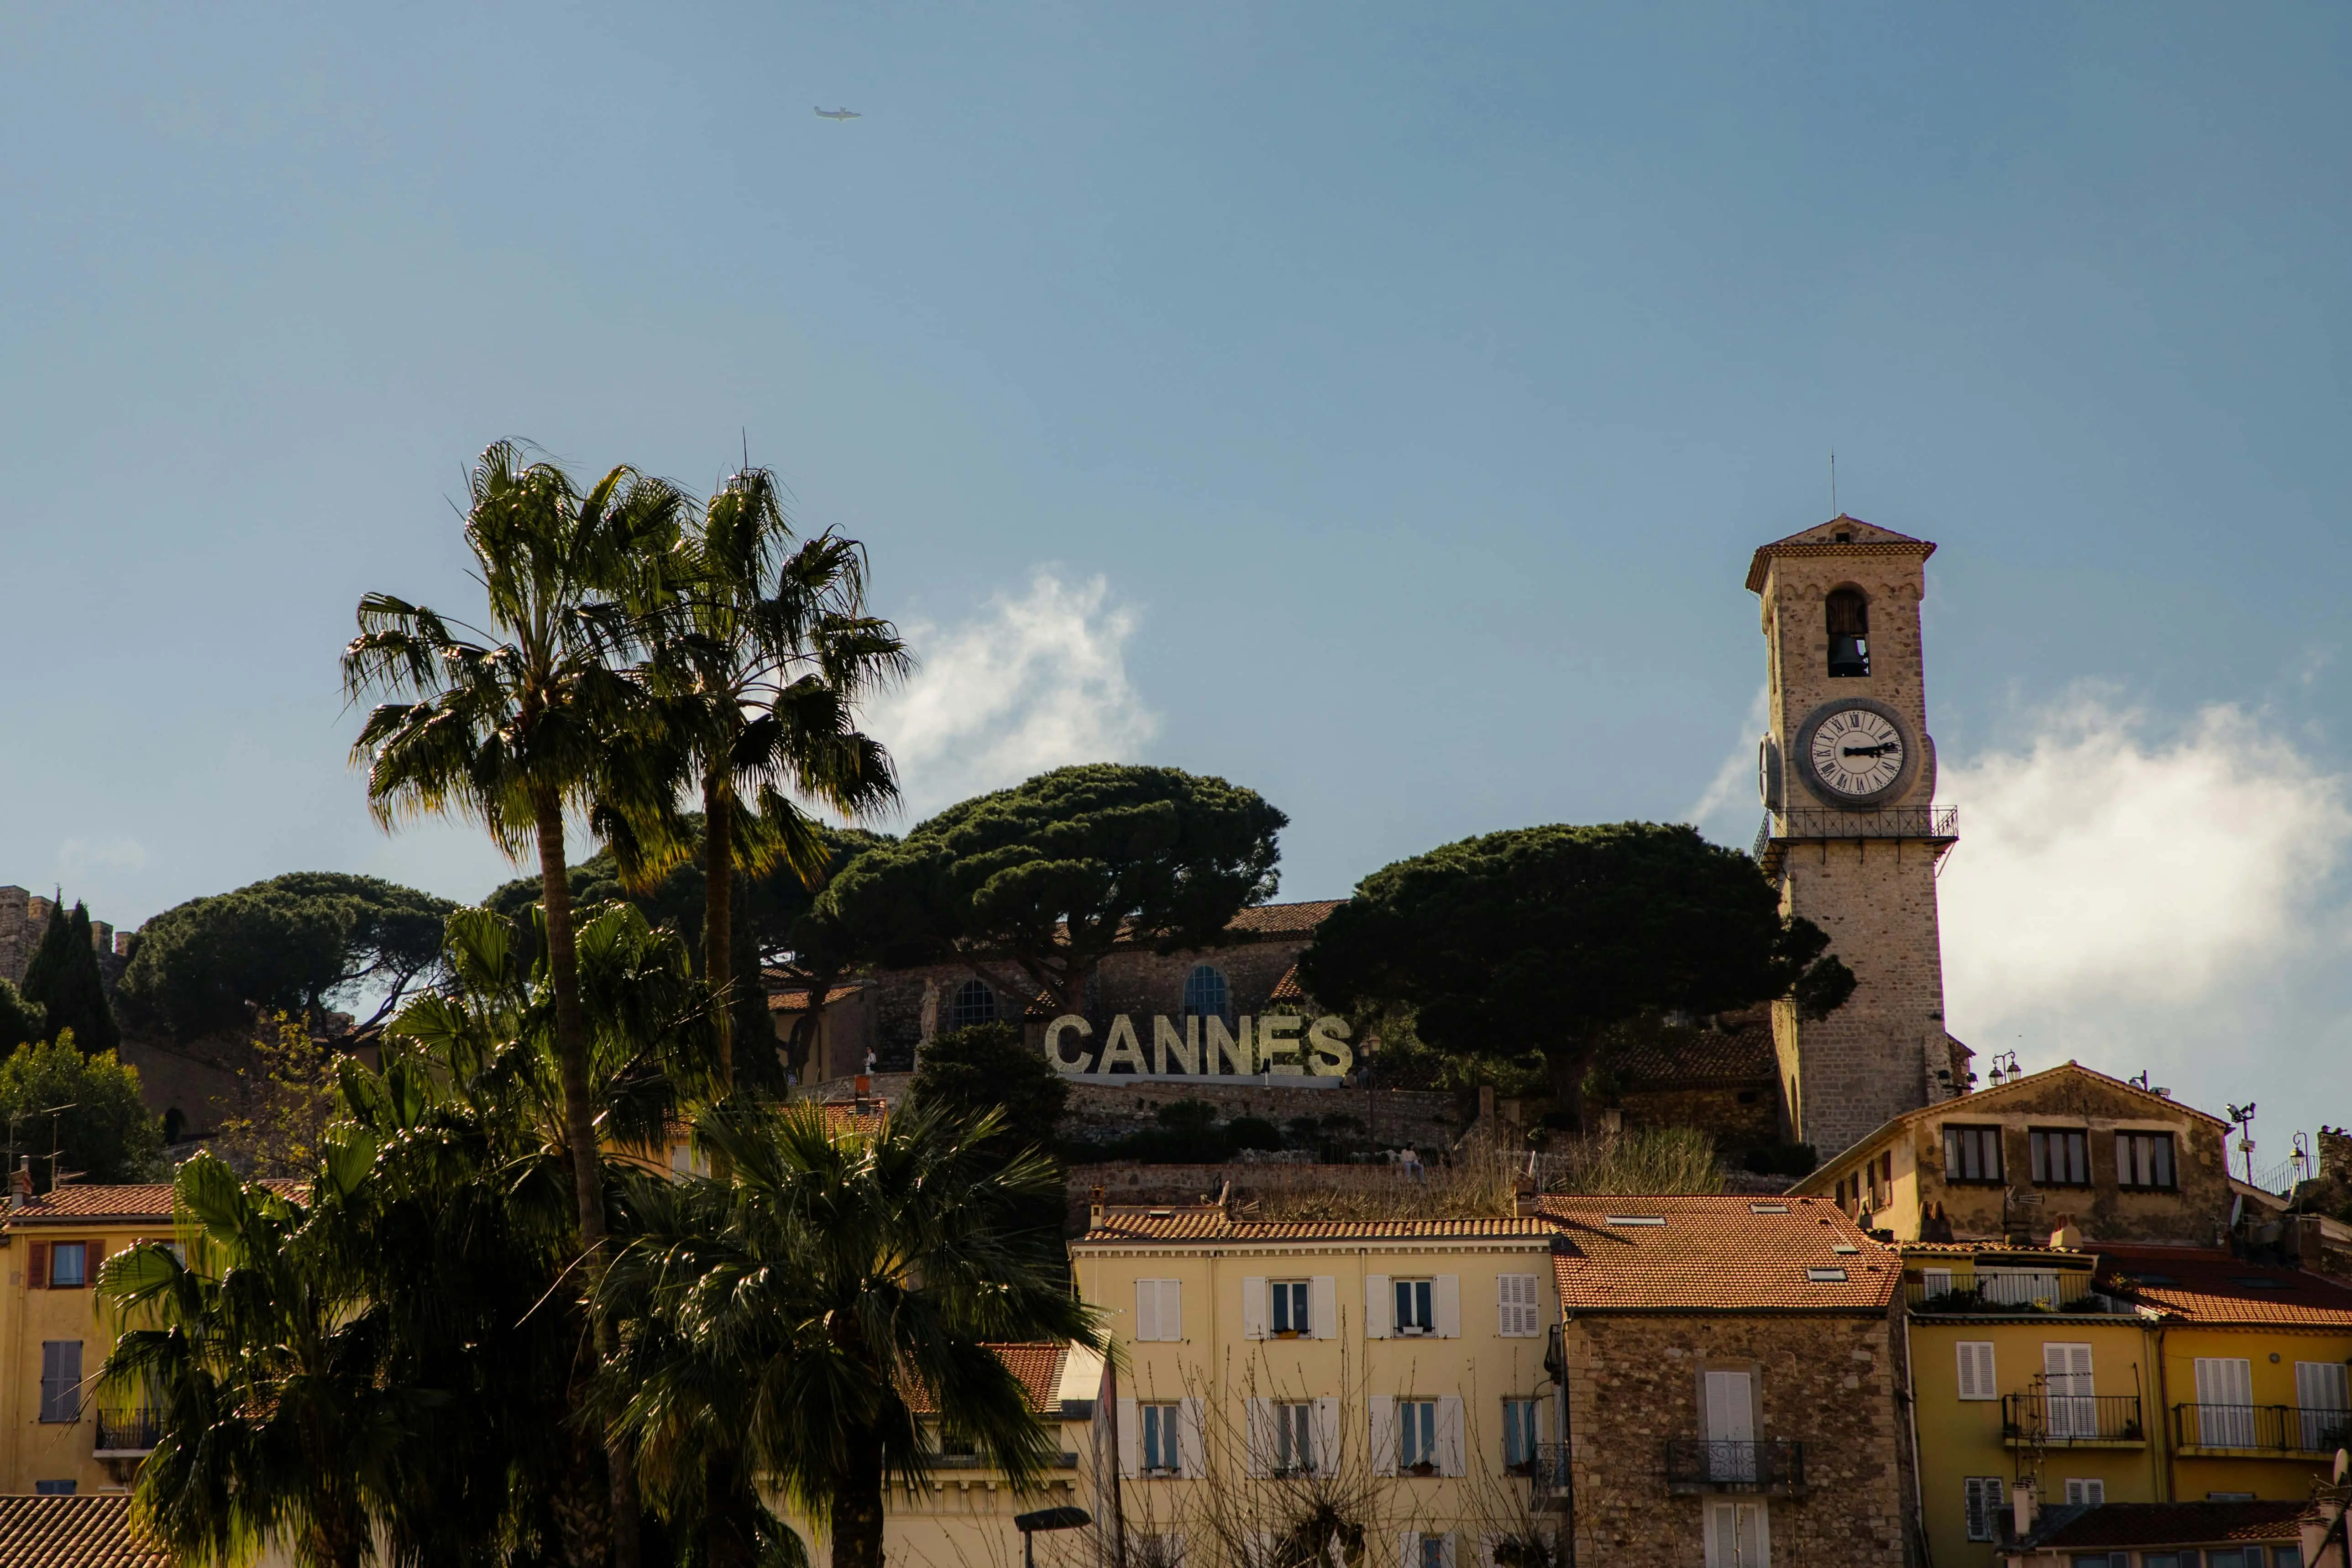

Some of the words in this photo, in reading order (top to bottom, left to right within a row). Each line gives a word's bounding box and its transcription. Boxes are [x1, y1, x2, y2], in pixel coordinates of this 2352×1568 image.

[1831, 719, 1845, 733] XI
[1849, 714, 1860, 728] XII
[1868, 718, 1875, 730] I
[1819, 733, 1834, 743] X
[1878, 730, 1892, 740] II
[1821, 762, 1837, 777] VIII
[1881, 762, 1896, 773] IV
[1837, 773, 1848, 788] VII
[1856, 777, 1865, 791] VI
[1872, 774, 1882, 786] V
[1045, 1014, 1353, 1076] CANNES
